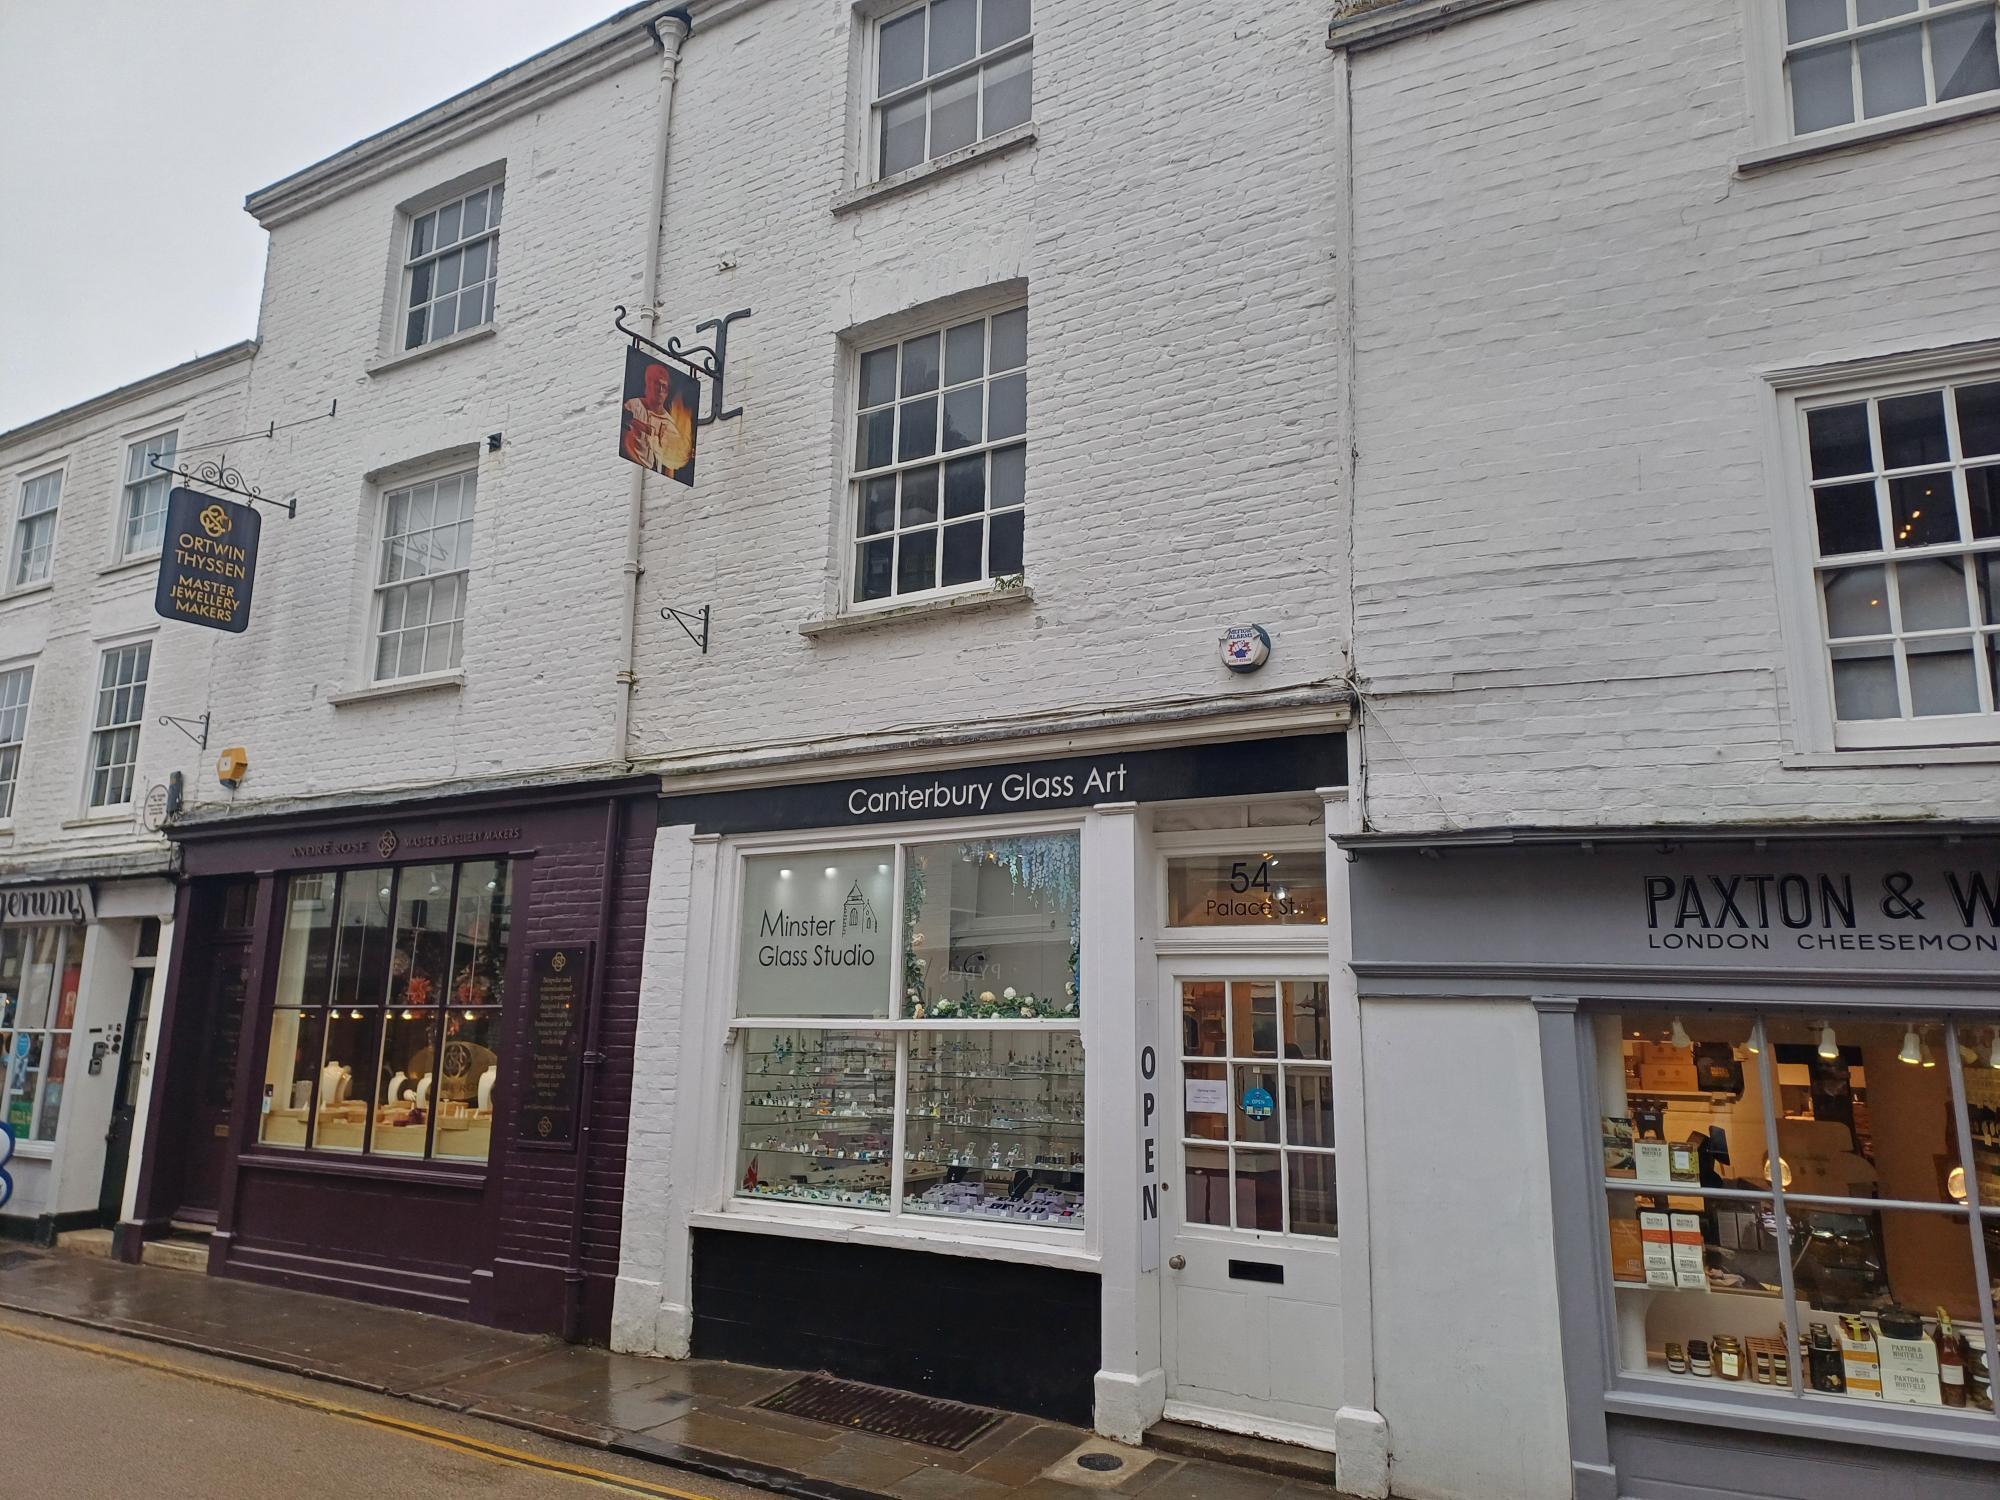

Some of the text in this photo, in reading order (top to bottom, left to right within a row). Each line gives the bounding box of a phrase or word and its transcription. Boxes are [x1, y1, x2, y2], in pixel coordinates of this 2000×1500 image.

[179, 533, 245, 562] ORTWIN
[175, 549, 246, 579] THYSSEN
[178, 574, 235, 598] MASTER
[170, 585, 240, 611] JEWELLERY
[175, 599, 232, 622] MAKERS
[848, 763, 1127, 815] Canterbury Glass Art
[483, 827, 522, 842] MAKERS
[1230, 861, 1271, 894] 54
[1206, 899, 1272, 917] Palace
[1643, 874, 1857, 929] PAXTON
[1879, 872, 1927, 920] &
[759, 909, 836, 937] Minster
[1648, 933, 1770, 950] LONDON
[758, 944, 875, 967] Glass Studio
[1141, 1045, 1158, 1221] OPEN
[1891, 1344, 1917, 1353] PAXTON
[1893, 1351, 1923, 1360] WHITFIELD
[1894, 1374, 1920, 1383] PAXTON
[1895, 1381, 1926, 1390] WHITFIELD
